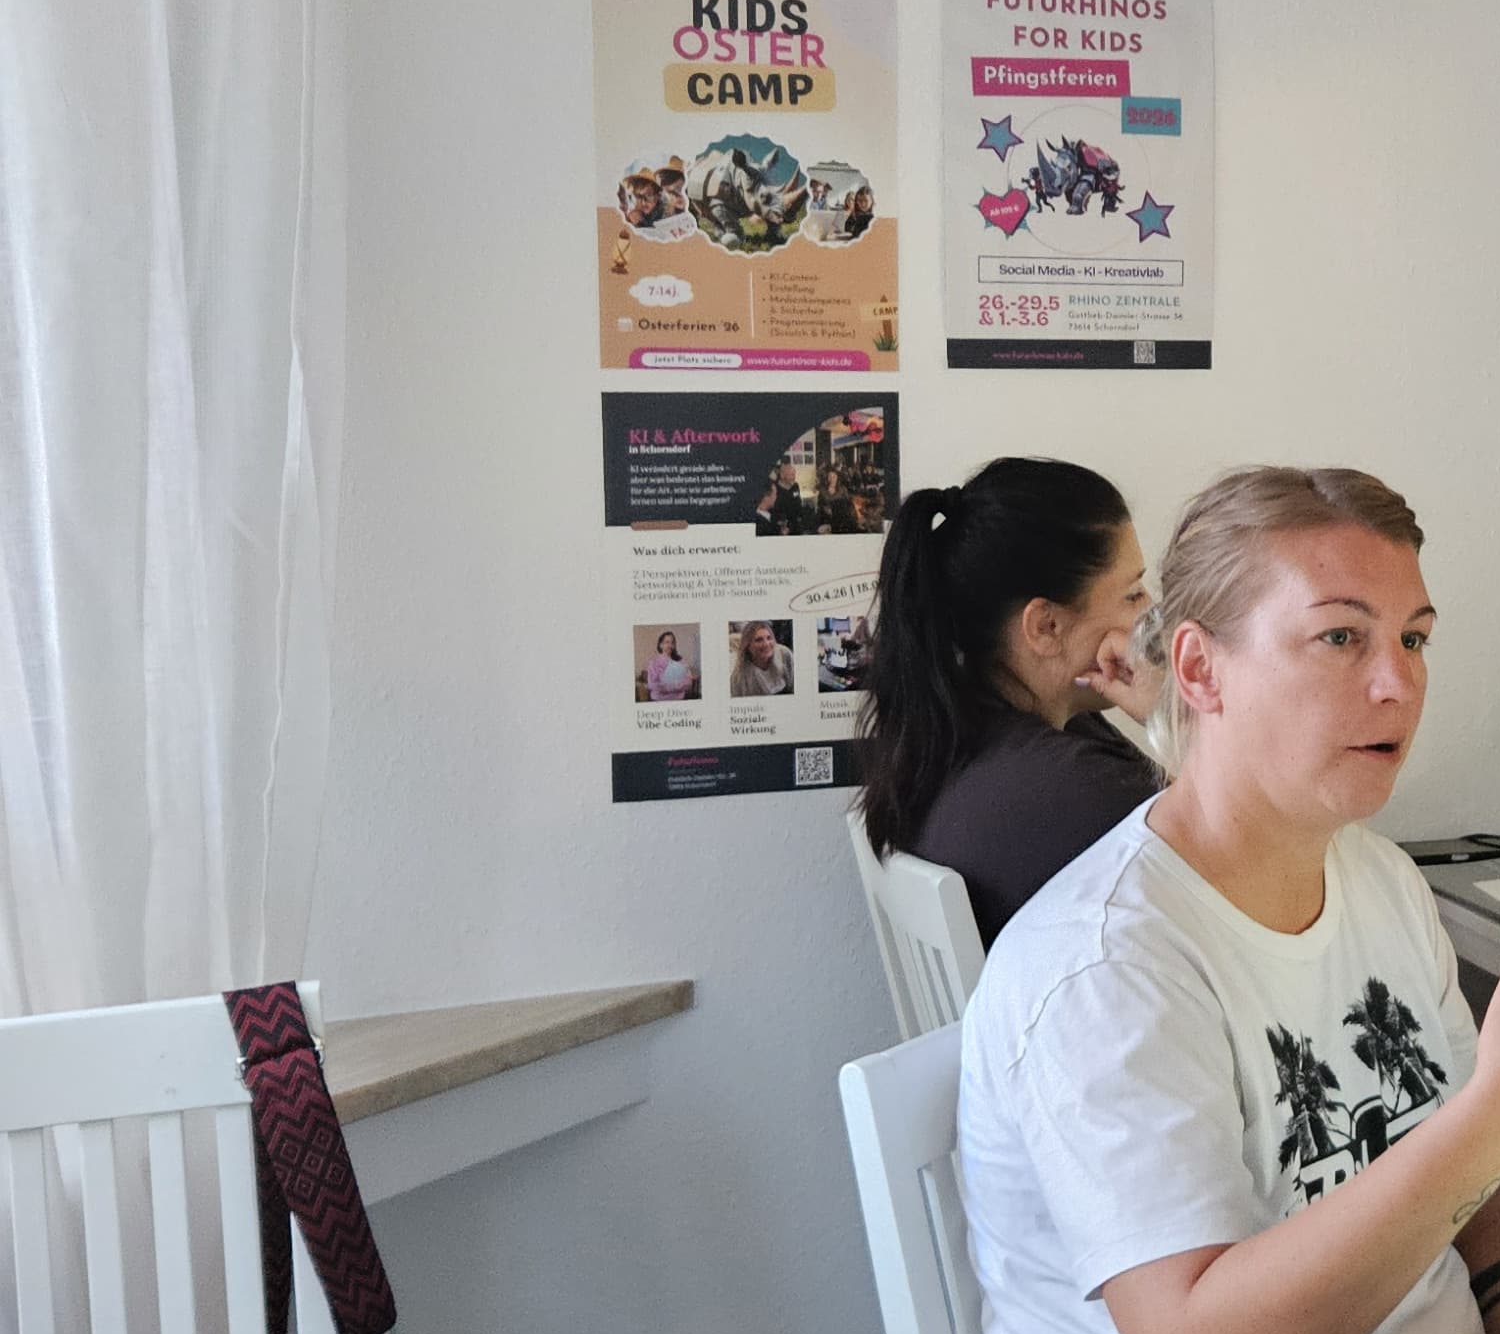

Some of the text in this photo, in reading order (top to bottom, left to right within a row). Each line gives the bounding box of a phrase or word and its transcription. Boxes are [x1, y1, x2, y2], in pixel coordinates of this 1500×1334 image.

[673, 25, 827, 68] OSTER
[1013, 25, 1143, 53] FOR KIDS
[984, 65, 1117, 89] Pfingstferien
[687, 72, 813, 105] CAMP
[999, 263, 1035, 276] Social
[1038, 265, 1075, 276] Media
[1084, 266, 1096, 277] KI
[1104, 267, 1164, 278] Kreativlab
[979, 294, 1060, 311] 26.-29.5
[1068, 294, 1181, 307] RHINO ZENTRALE
[638, 318, 716, 331] Osterferien
[979, 311, 1048, 326] & 1.-3.6
[629, 427, 760, 444] KI & Afterwork
[629, 444, 691, 454] in Schorndorf
[633, 546, 657, 556] Was
[660, 545, 686, 556] dich
[806, 587, 848, 605] 30.4.26
[637, 718, 702, 730] Vibe Coding
[730, 715, 767, 725] Soziale
[730, 725, 776, 736] Wirkung
